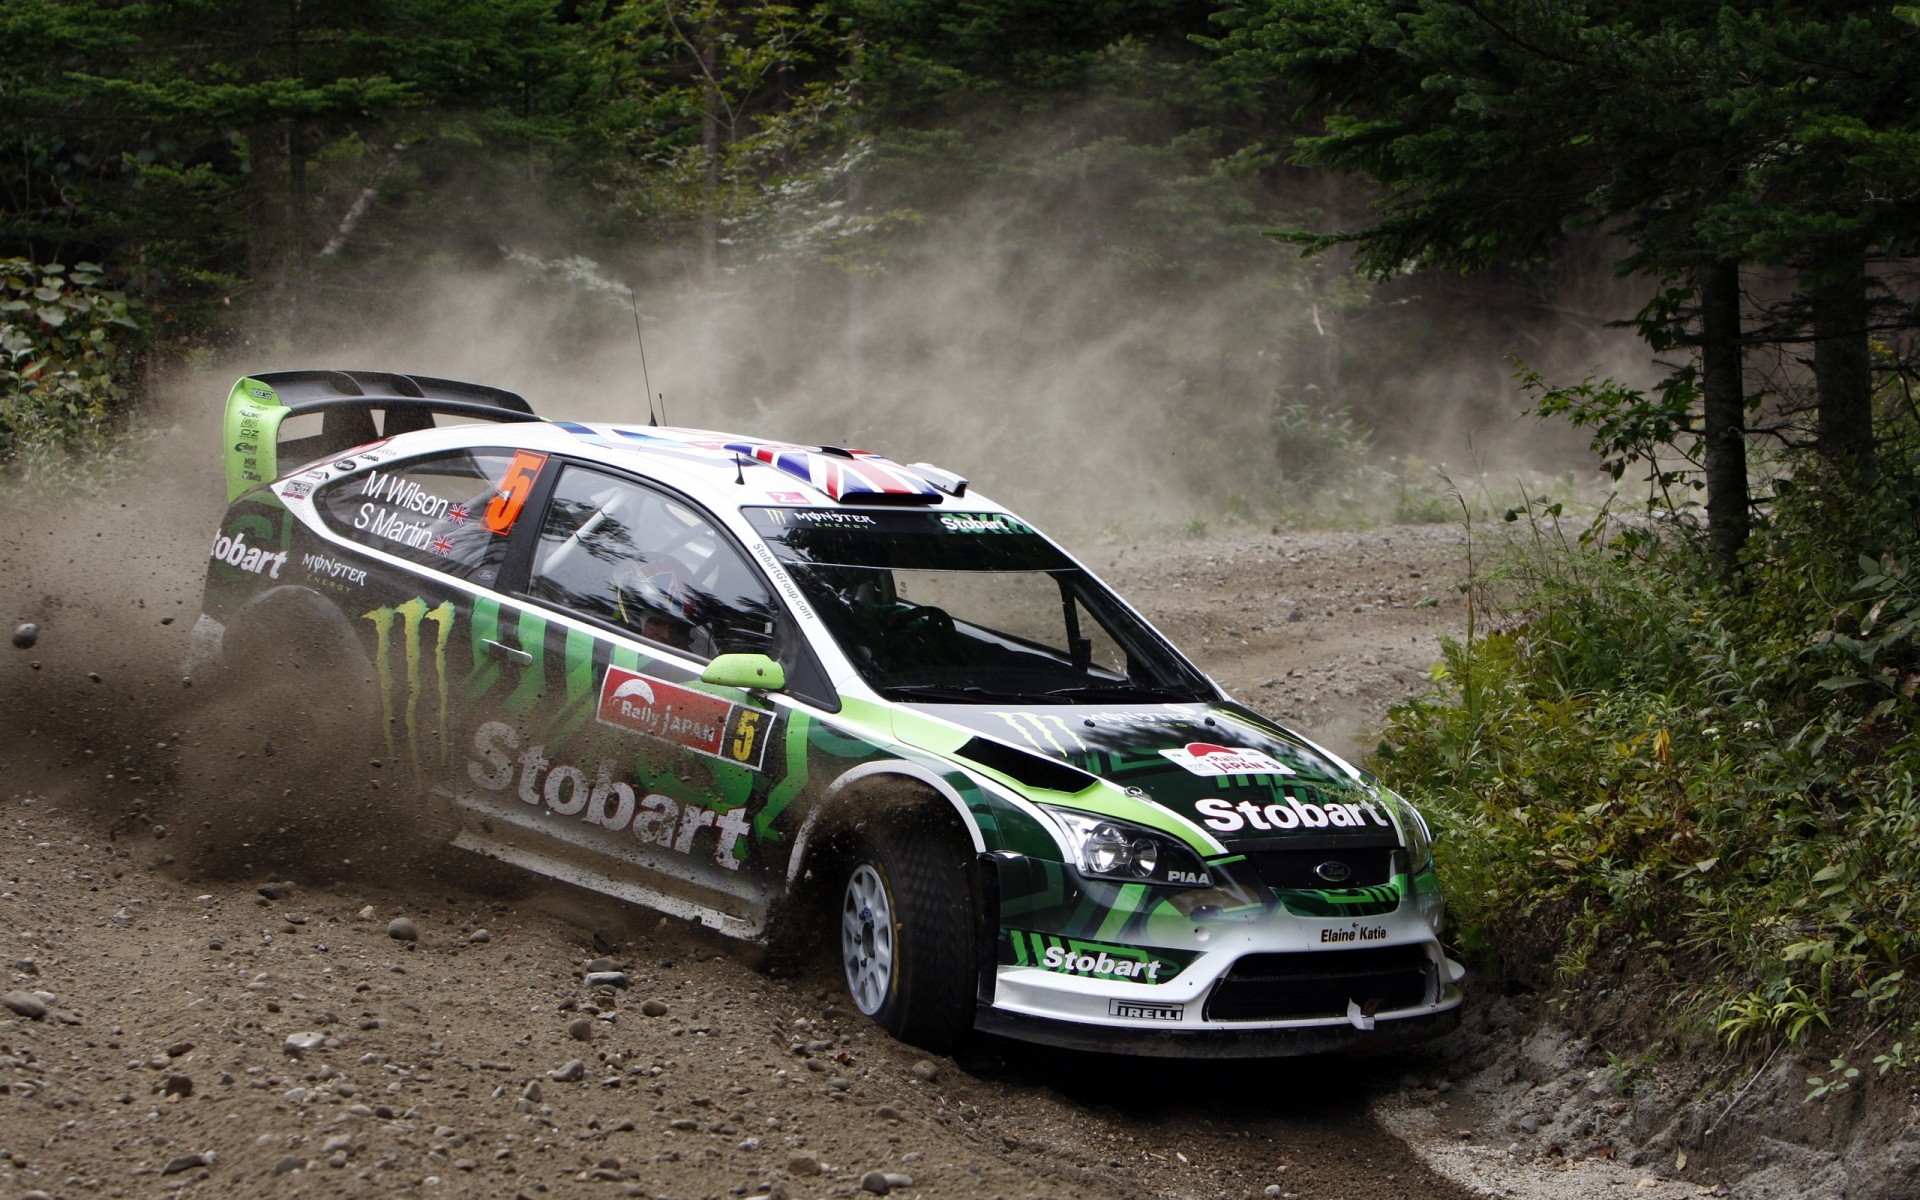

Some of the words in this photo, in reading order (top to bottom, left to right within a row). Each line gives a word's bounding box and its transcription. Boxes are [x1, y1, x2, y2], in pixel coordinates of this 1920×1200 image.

[362, 470, 388, 499] M
[386, 475, 449, 519] Wilson
[485, 452, 543, 531] 5
[354, 502, 375, 530] S
[371, 508, 433, 551] Martin
[940, 516, 1010, 532] Stobart
[753, 543, 814, 621] StobartGroup.com
[620, 700, 661, 728] Rally
[732, 709, 760, 762] 5
[1210, 755, 1246, 763] Rally
[1265, 760, 1281, 770] 5
[467, 720, 751, 871] Stobart
[1195, 796, 1389, 832] Stobart
[1168, 870, 1210, 885] PIAA
[1321, 928, 1355, 943] Elaine
[1359, 926, 1387, 941] Katie
[1042, 946, 1162, 979] Stobart
[1109, 999, 1183, 1021] PIRELLI
